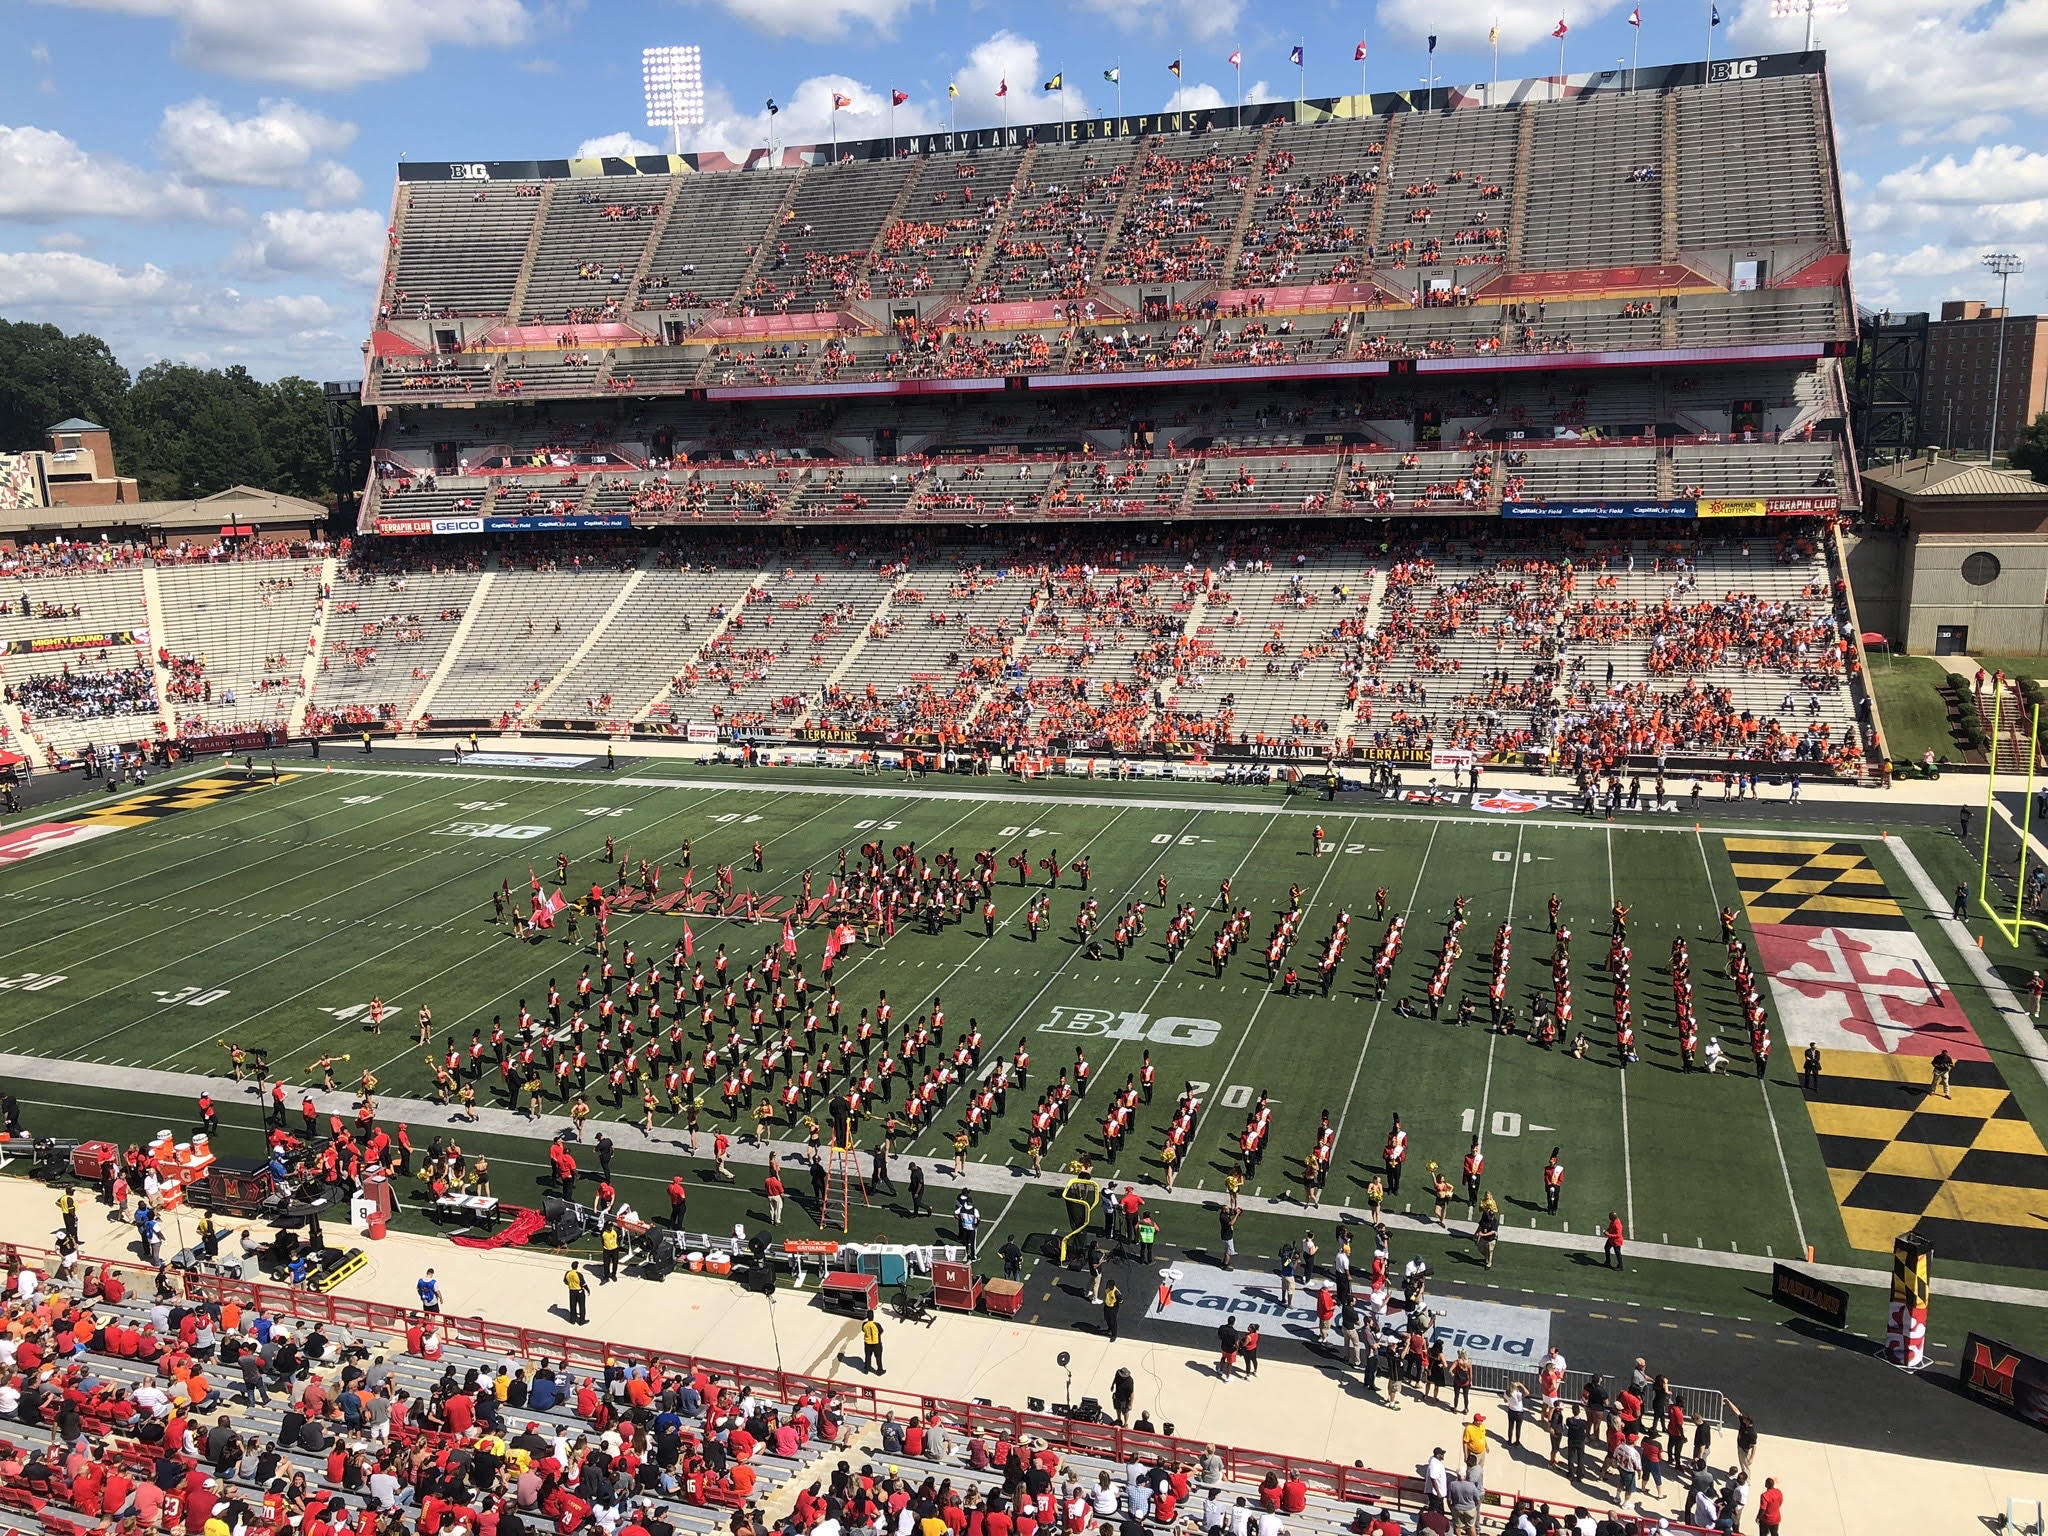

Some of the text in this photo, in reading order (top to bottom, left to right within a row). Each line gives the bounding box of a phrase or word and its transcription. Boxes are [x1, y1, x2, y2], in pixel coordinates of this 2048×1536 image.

[909, 113, 1198, 153] MARYLAND TERRAPINS
[1769, 498, 1837, 510] TERRAPIN CLUB
[380, 521, 431, 533] TERRAPIN CLUB
[435, 521, 480, 531] GEICO
[31, 638, 69, 647] MIGHTY
[70, 634, 104, 643] SOUND
[31, 639, 113, 652] MARYLAND
[689, 729, 717, 739] ESPN
[802, 729, 858, 742] TERRAPINS
[1249, 745, 1315, 758] MARYLAND
[1362, 748, 1432, 761] TERRAPINS
[1433, 754, 1470, 766] ESPN
[156, 986, 232, 1006] 30
[332, 1003, 403, 1024] 40
[1461, 1108, 1522, 1137] 10
[224, 1178, 241, 1198] M
[945, 1270, 957, 1282] M
[1432, 1326, 1534, 1358] Field
[1968, 1342, 2022, 1401] M
[686, 1479, 696, 1493] 16
[563, 1510, 573, 1525] 29
